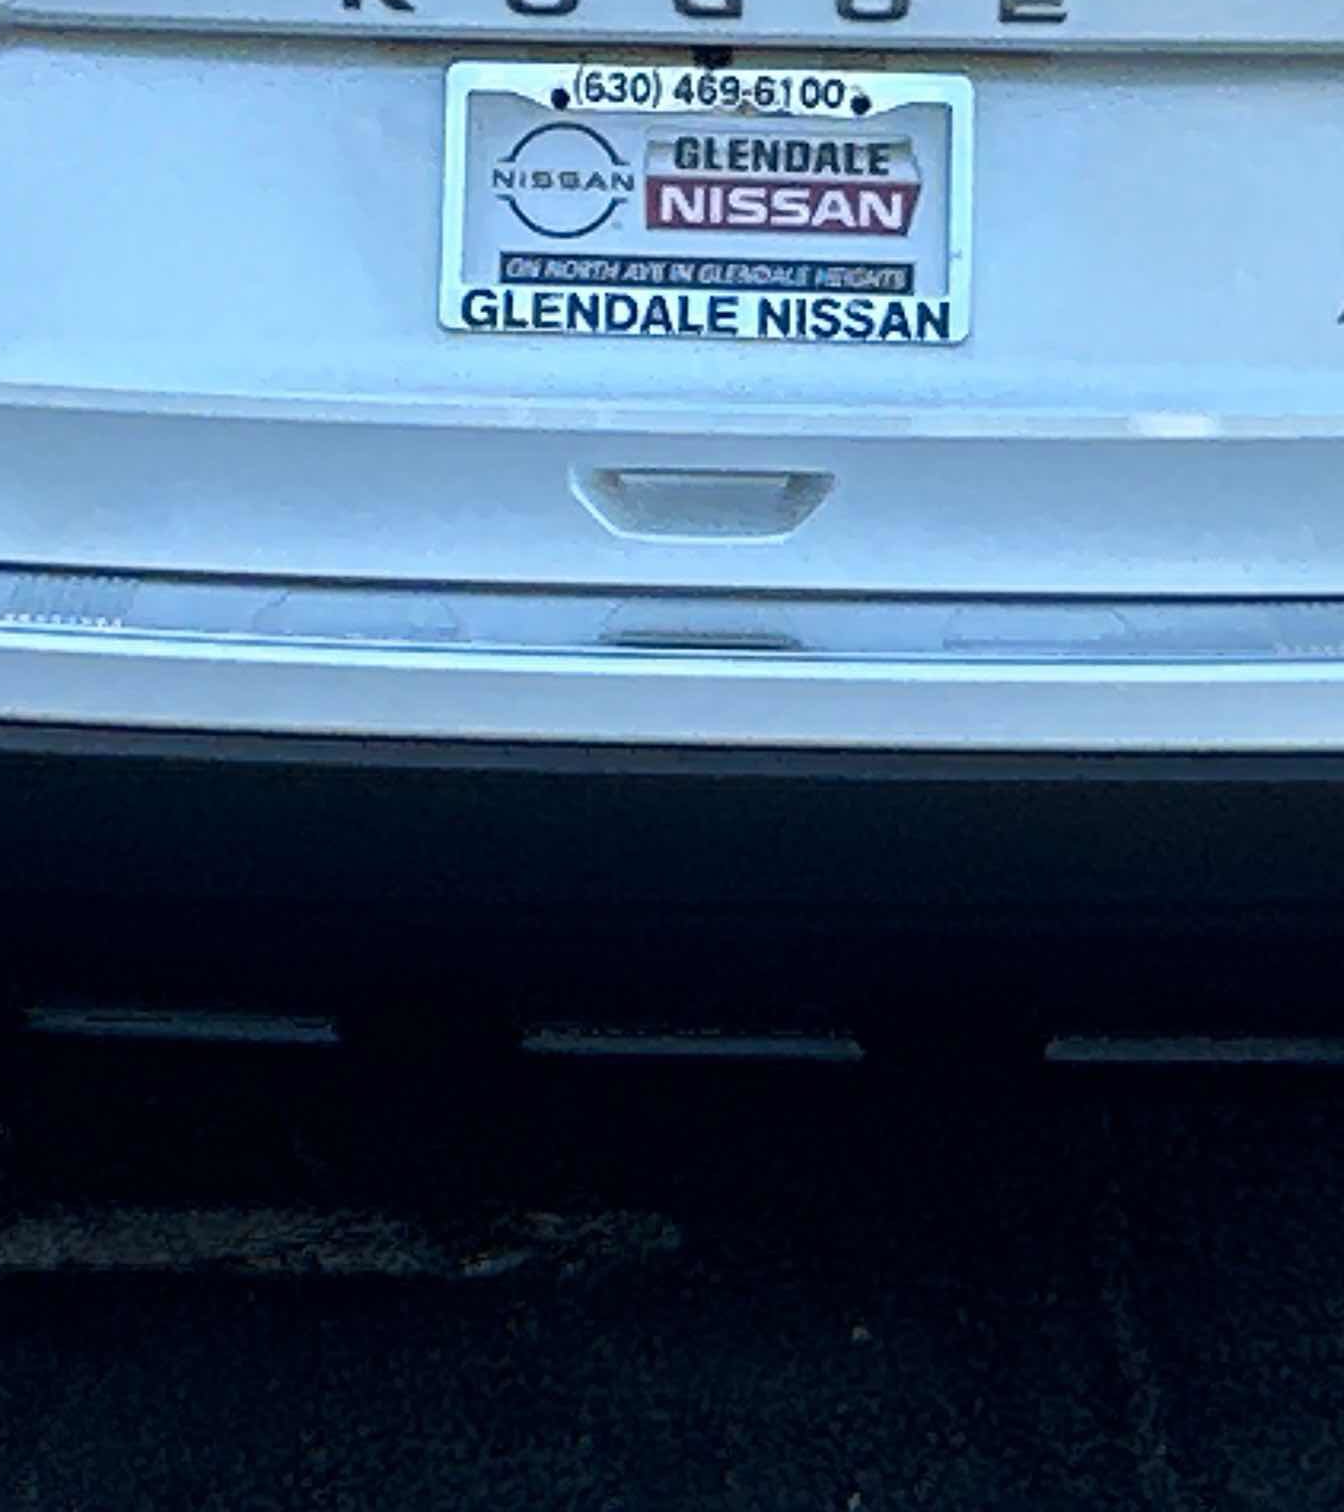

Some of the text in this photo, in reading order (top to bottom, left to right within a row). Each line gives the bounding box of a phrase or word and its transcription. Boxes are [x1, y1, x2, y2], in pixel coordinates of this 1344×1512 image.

[571, 65, 846, 110] (630) 469-6100
[674, 136, 891, 176] GLENDALE
[493, 168, 635, 192] NISSAN
[660, 185, 903, 229] NISSAN
[460, 289, 950, 339] GLENDALE NISSAN
